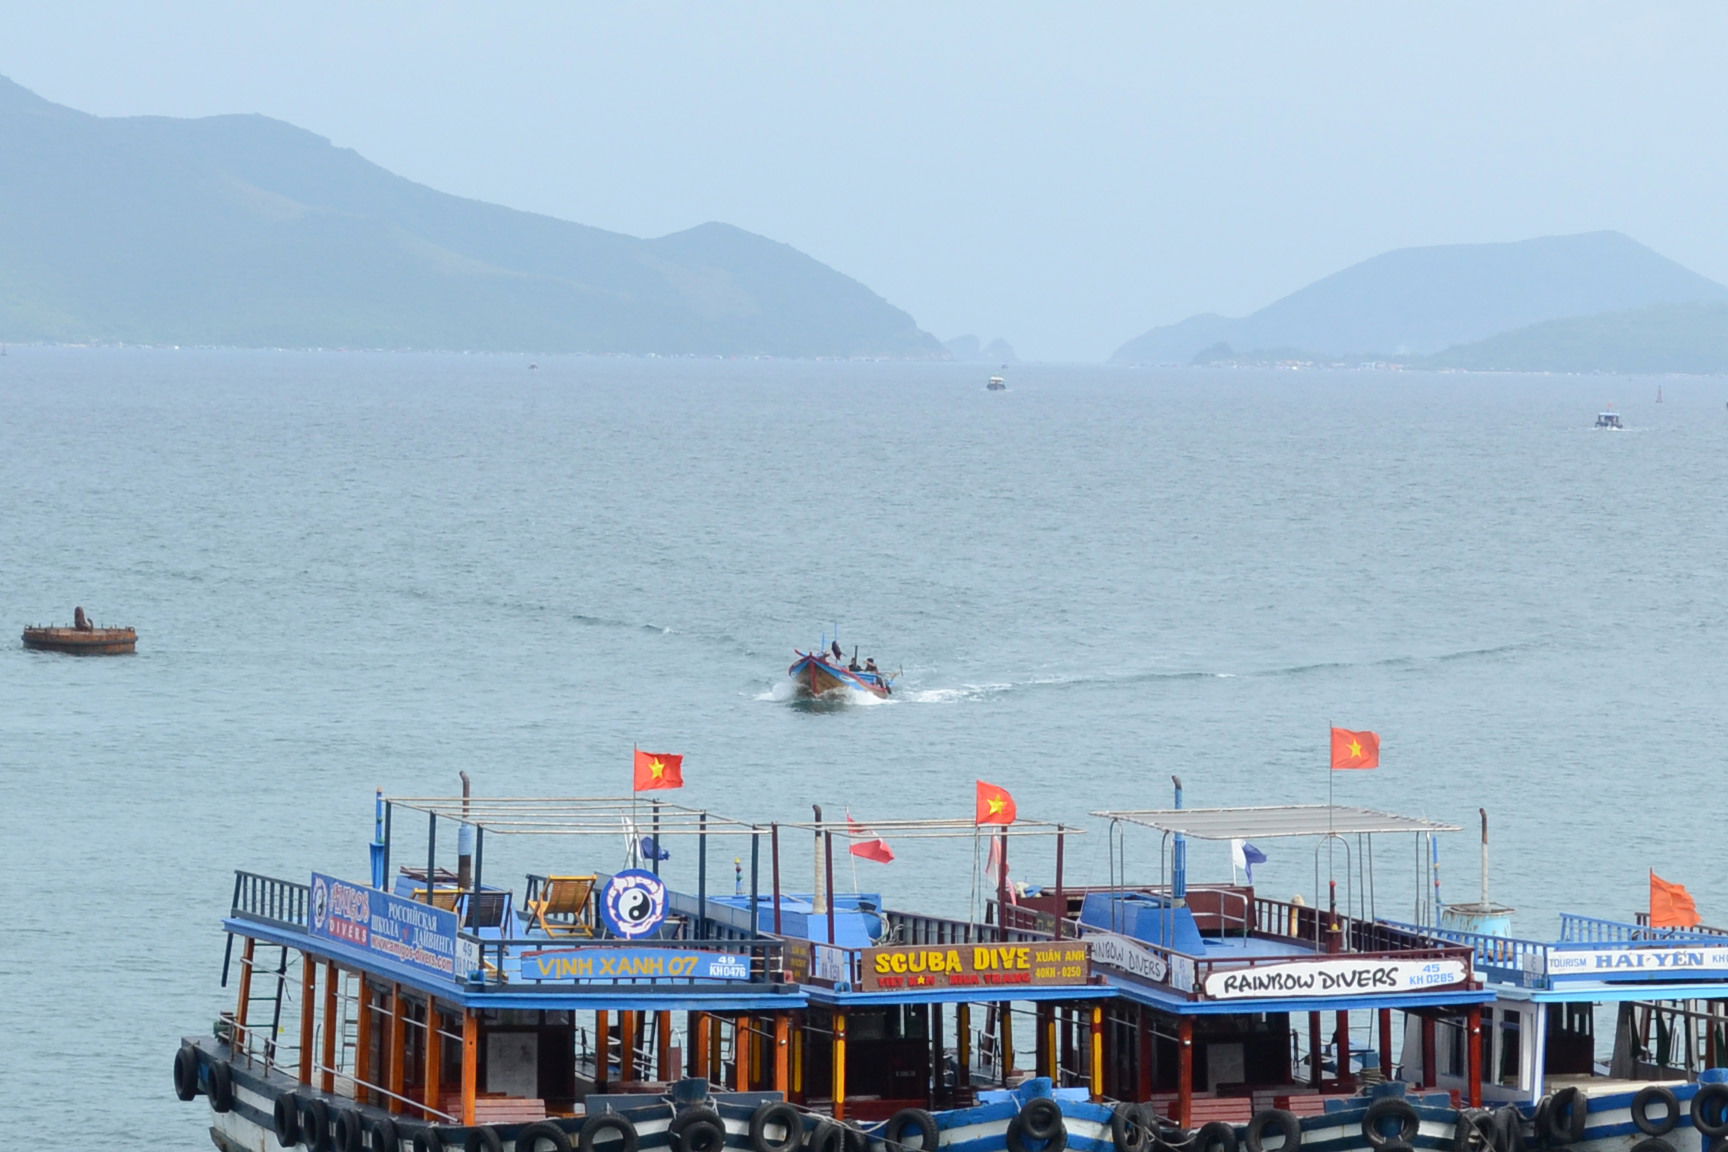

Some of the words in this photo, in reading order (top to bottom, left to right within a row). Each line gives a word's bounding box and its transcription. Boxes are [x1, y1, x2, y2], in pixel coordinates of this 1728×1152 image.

[329, 919, 367, 943] DIVERS
[371, 915, 399, 938] ШКОЛА
[599, 956, 664, 976] XANH
[668, 956, 699, 976] 07
[874, 949, 963, 974] SCUBA
[973, 946, 1031, 971] DIVE
[1065, 950, 1086, 961] ANH
[1128, 950, 1161, 977] DIVERS
[1550, 958, 1587, 968] TOURISM
[1422, 963, 1440, 973] 45
[1224, 972, 1315, 994] RAINBOW
[1318, 967, 1399, 990] DIVERS
